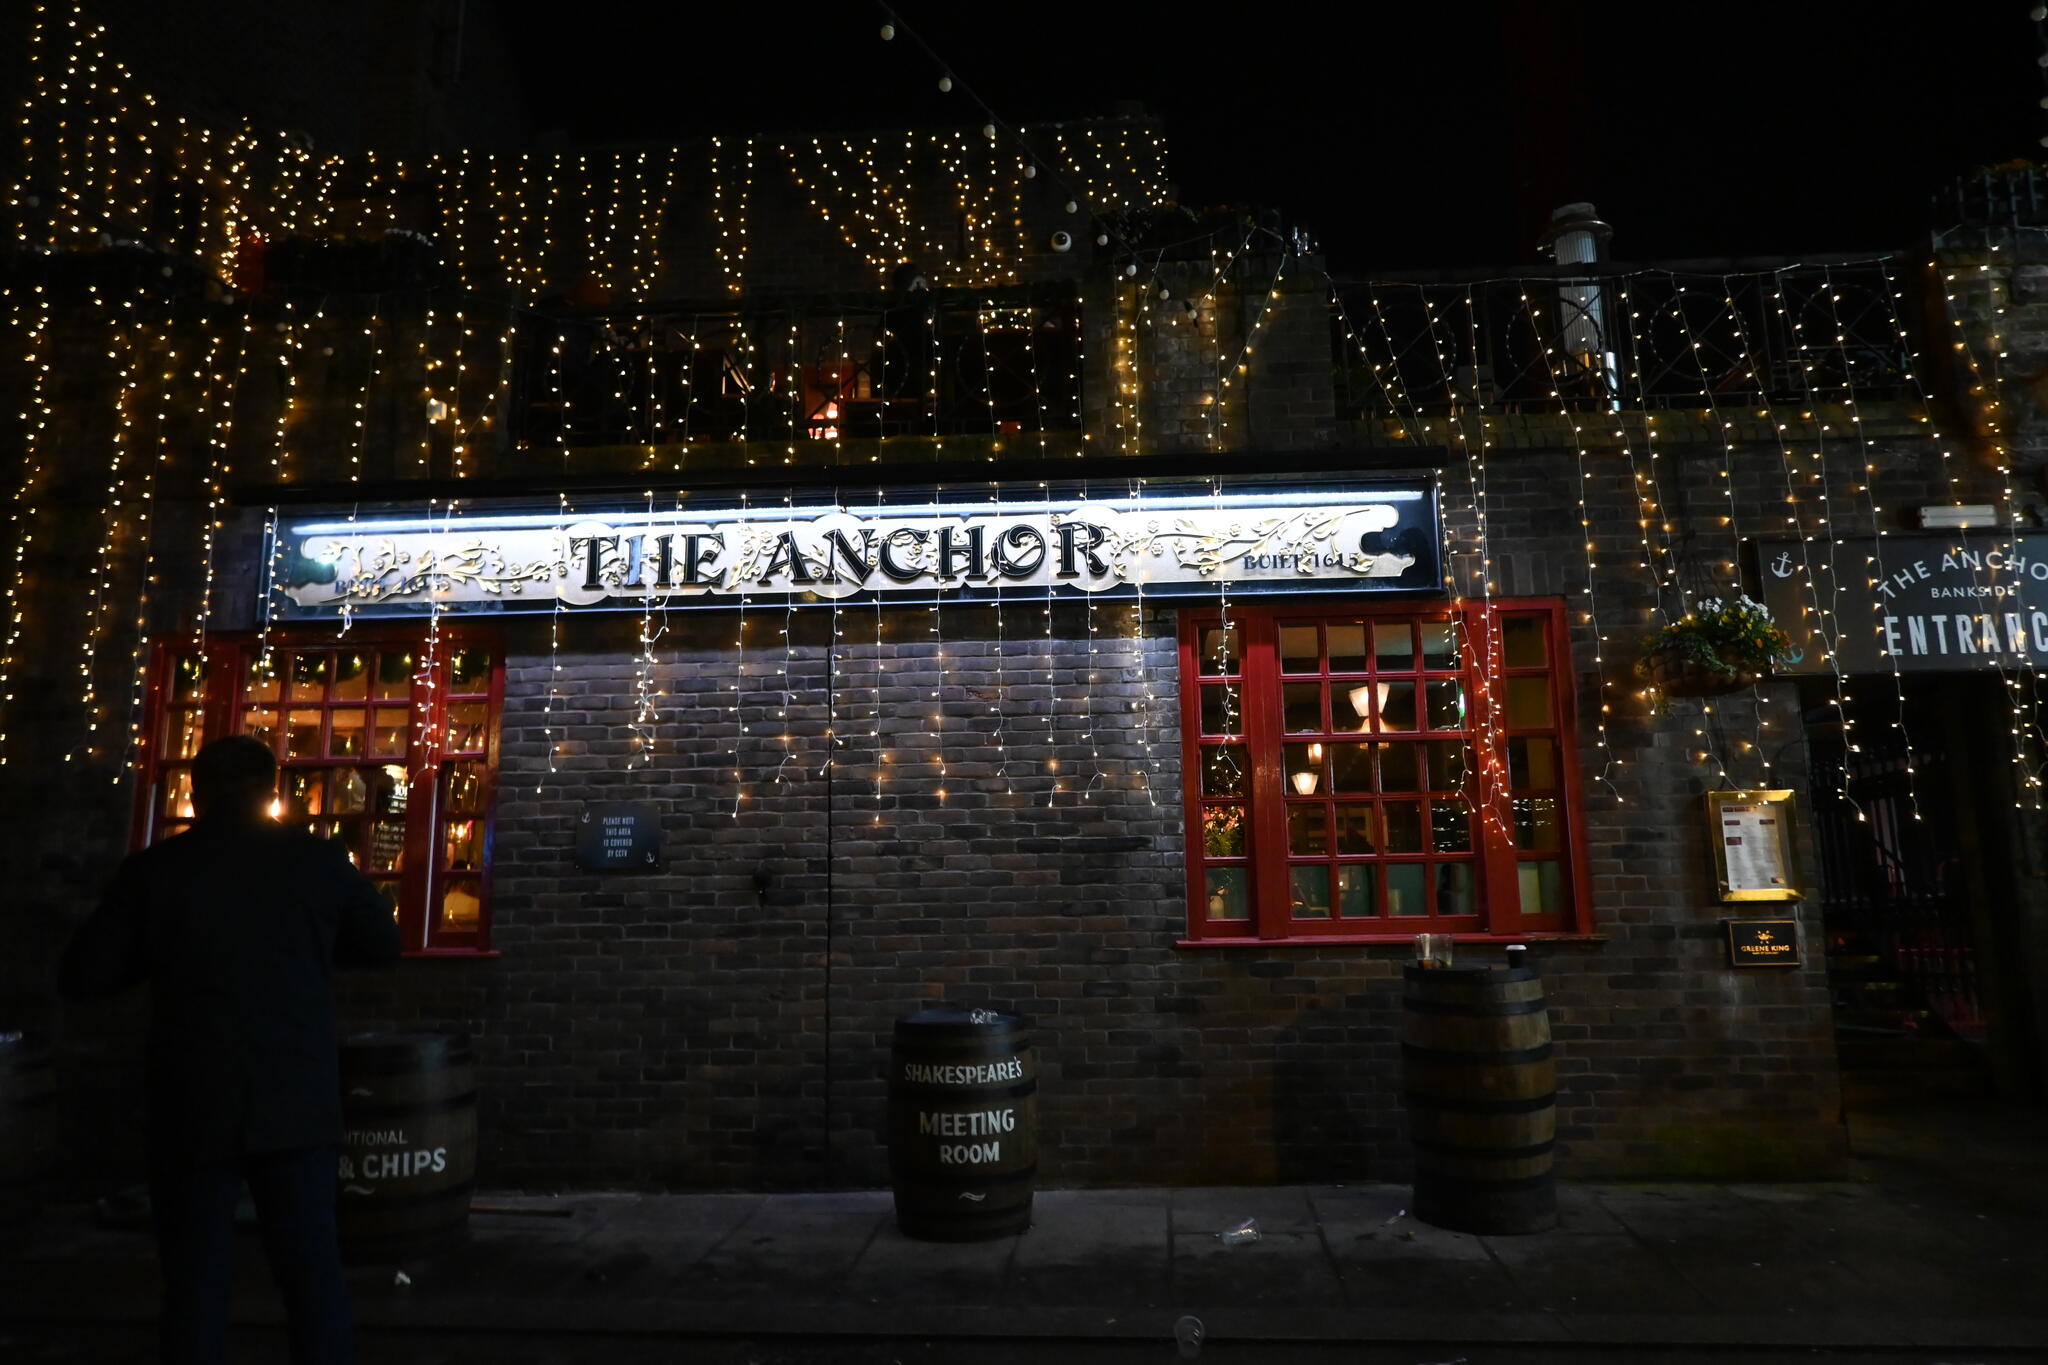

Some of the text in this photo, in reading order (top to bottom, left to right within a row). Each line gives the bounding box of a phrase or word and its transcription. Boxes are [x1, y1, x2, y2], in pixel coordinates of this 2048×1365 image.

[569, 520, 1110, 590] THE ANCHOR
[1876, 560, 1931, 599] THE
[1931, 585, 2016, 598] BANKSIDE
[1771, 944, 1790, 952] KING
[904, 1056, 1023, 1085] SHAKESPEARE'S
[919, 1108, 1015, 1136] MEETING
[344, 1129, 409, 1146] ITIONAL
[338, 1146, 447, 1179] & CHIPS
[939, 1141, 1000, 1165] ROOM
